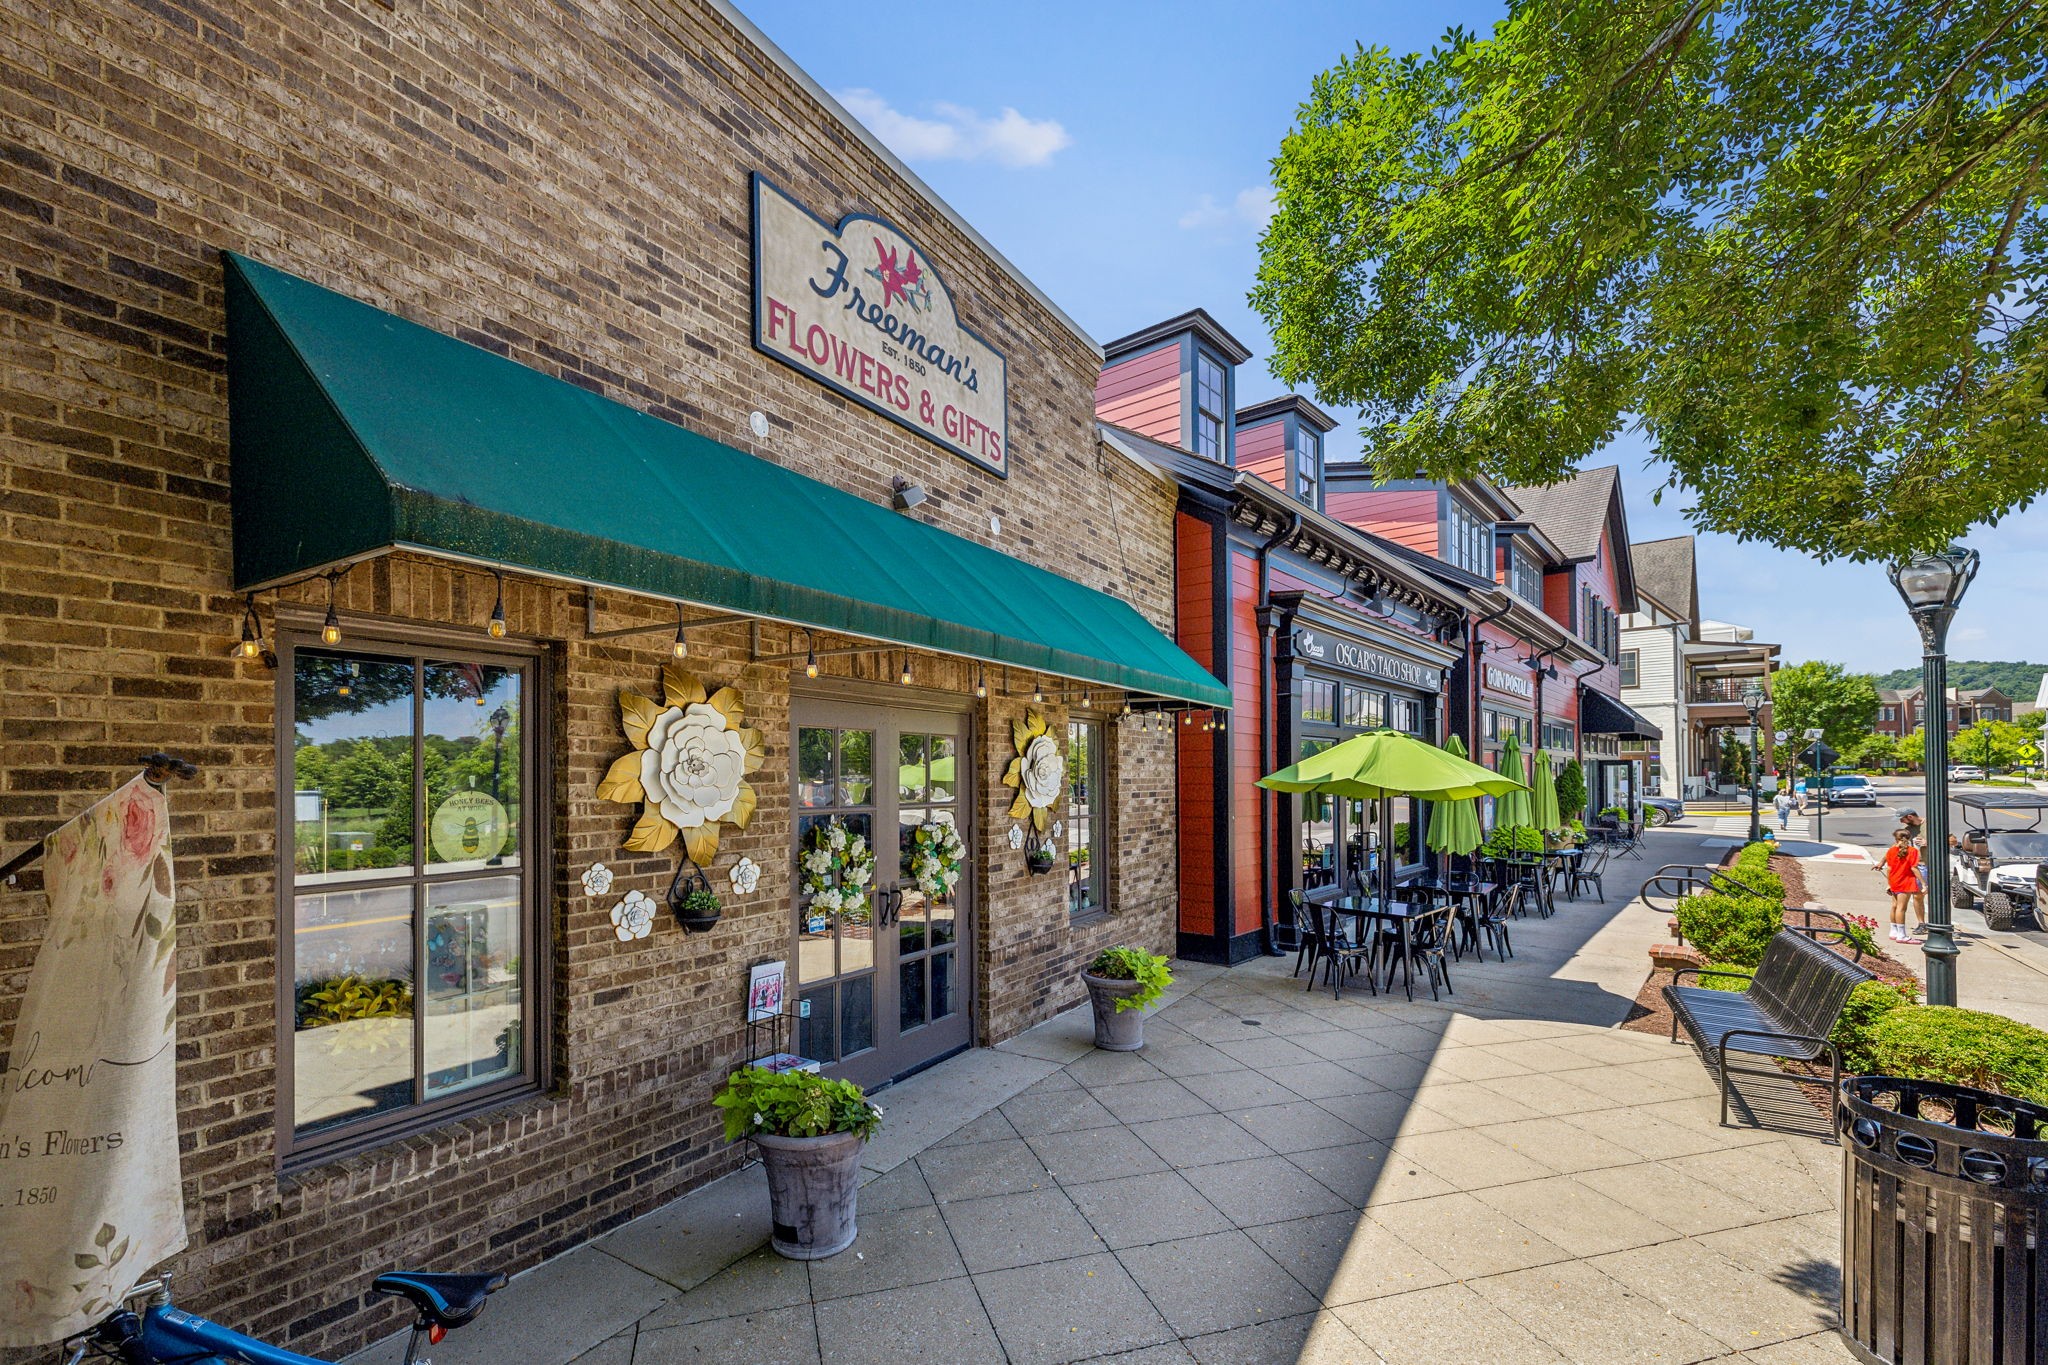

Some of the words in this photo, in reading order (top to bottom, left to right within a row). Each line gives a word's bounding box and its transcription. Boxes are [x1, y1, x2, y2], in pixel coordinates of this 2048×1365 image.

[809, 241, 978, 393] Freeman's
[767, 296, 911, 411] FLOWERS
[919, 389, 935, 427] &
[942, 404, 1001, 462] GIFTS
[903, 355, 926, 377] 1850
[1335, 643, 1376, 673] OSCAR'S
[1377, 655, 1400, 679] TACO
[1400, 662, 1421, 684] SHOP
[41, 1130, 124, 1156] Flowers
[15, 1186, 57, 1206] 1850
